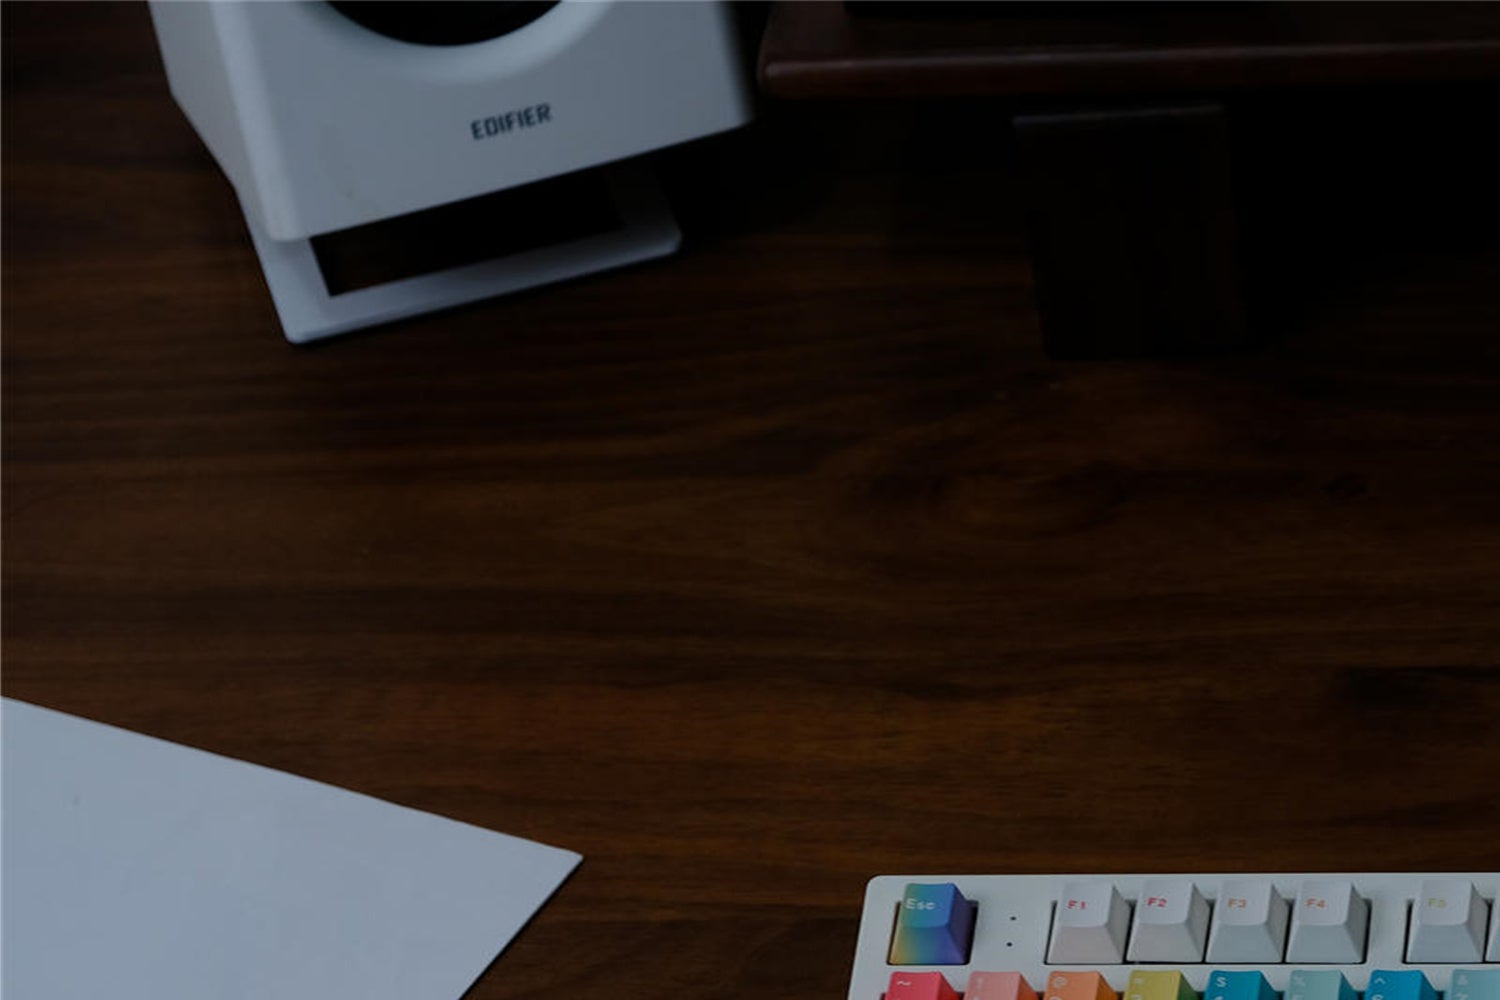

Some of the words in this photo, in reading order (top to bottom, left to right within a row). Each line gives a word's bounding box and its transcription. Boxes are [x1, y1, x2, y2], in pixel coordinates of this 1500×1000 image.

[470, 103, 552, 140] EDIFIER
[905, 899, 936, 911] Esc
[1068, 900, 1087, 909] F1
[1147, 898, 1167, 907] F2
[1228, 899, 1247, 908] F3
[1307, 899, 1326, 908] F4
[1428, 898, 1446, 907] F5
